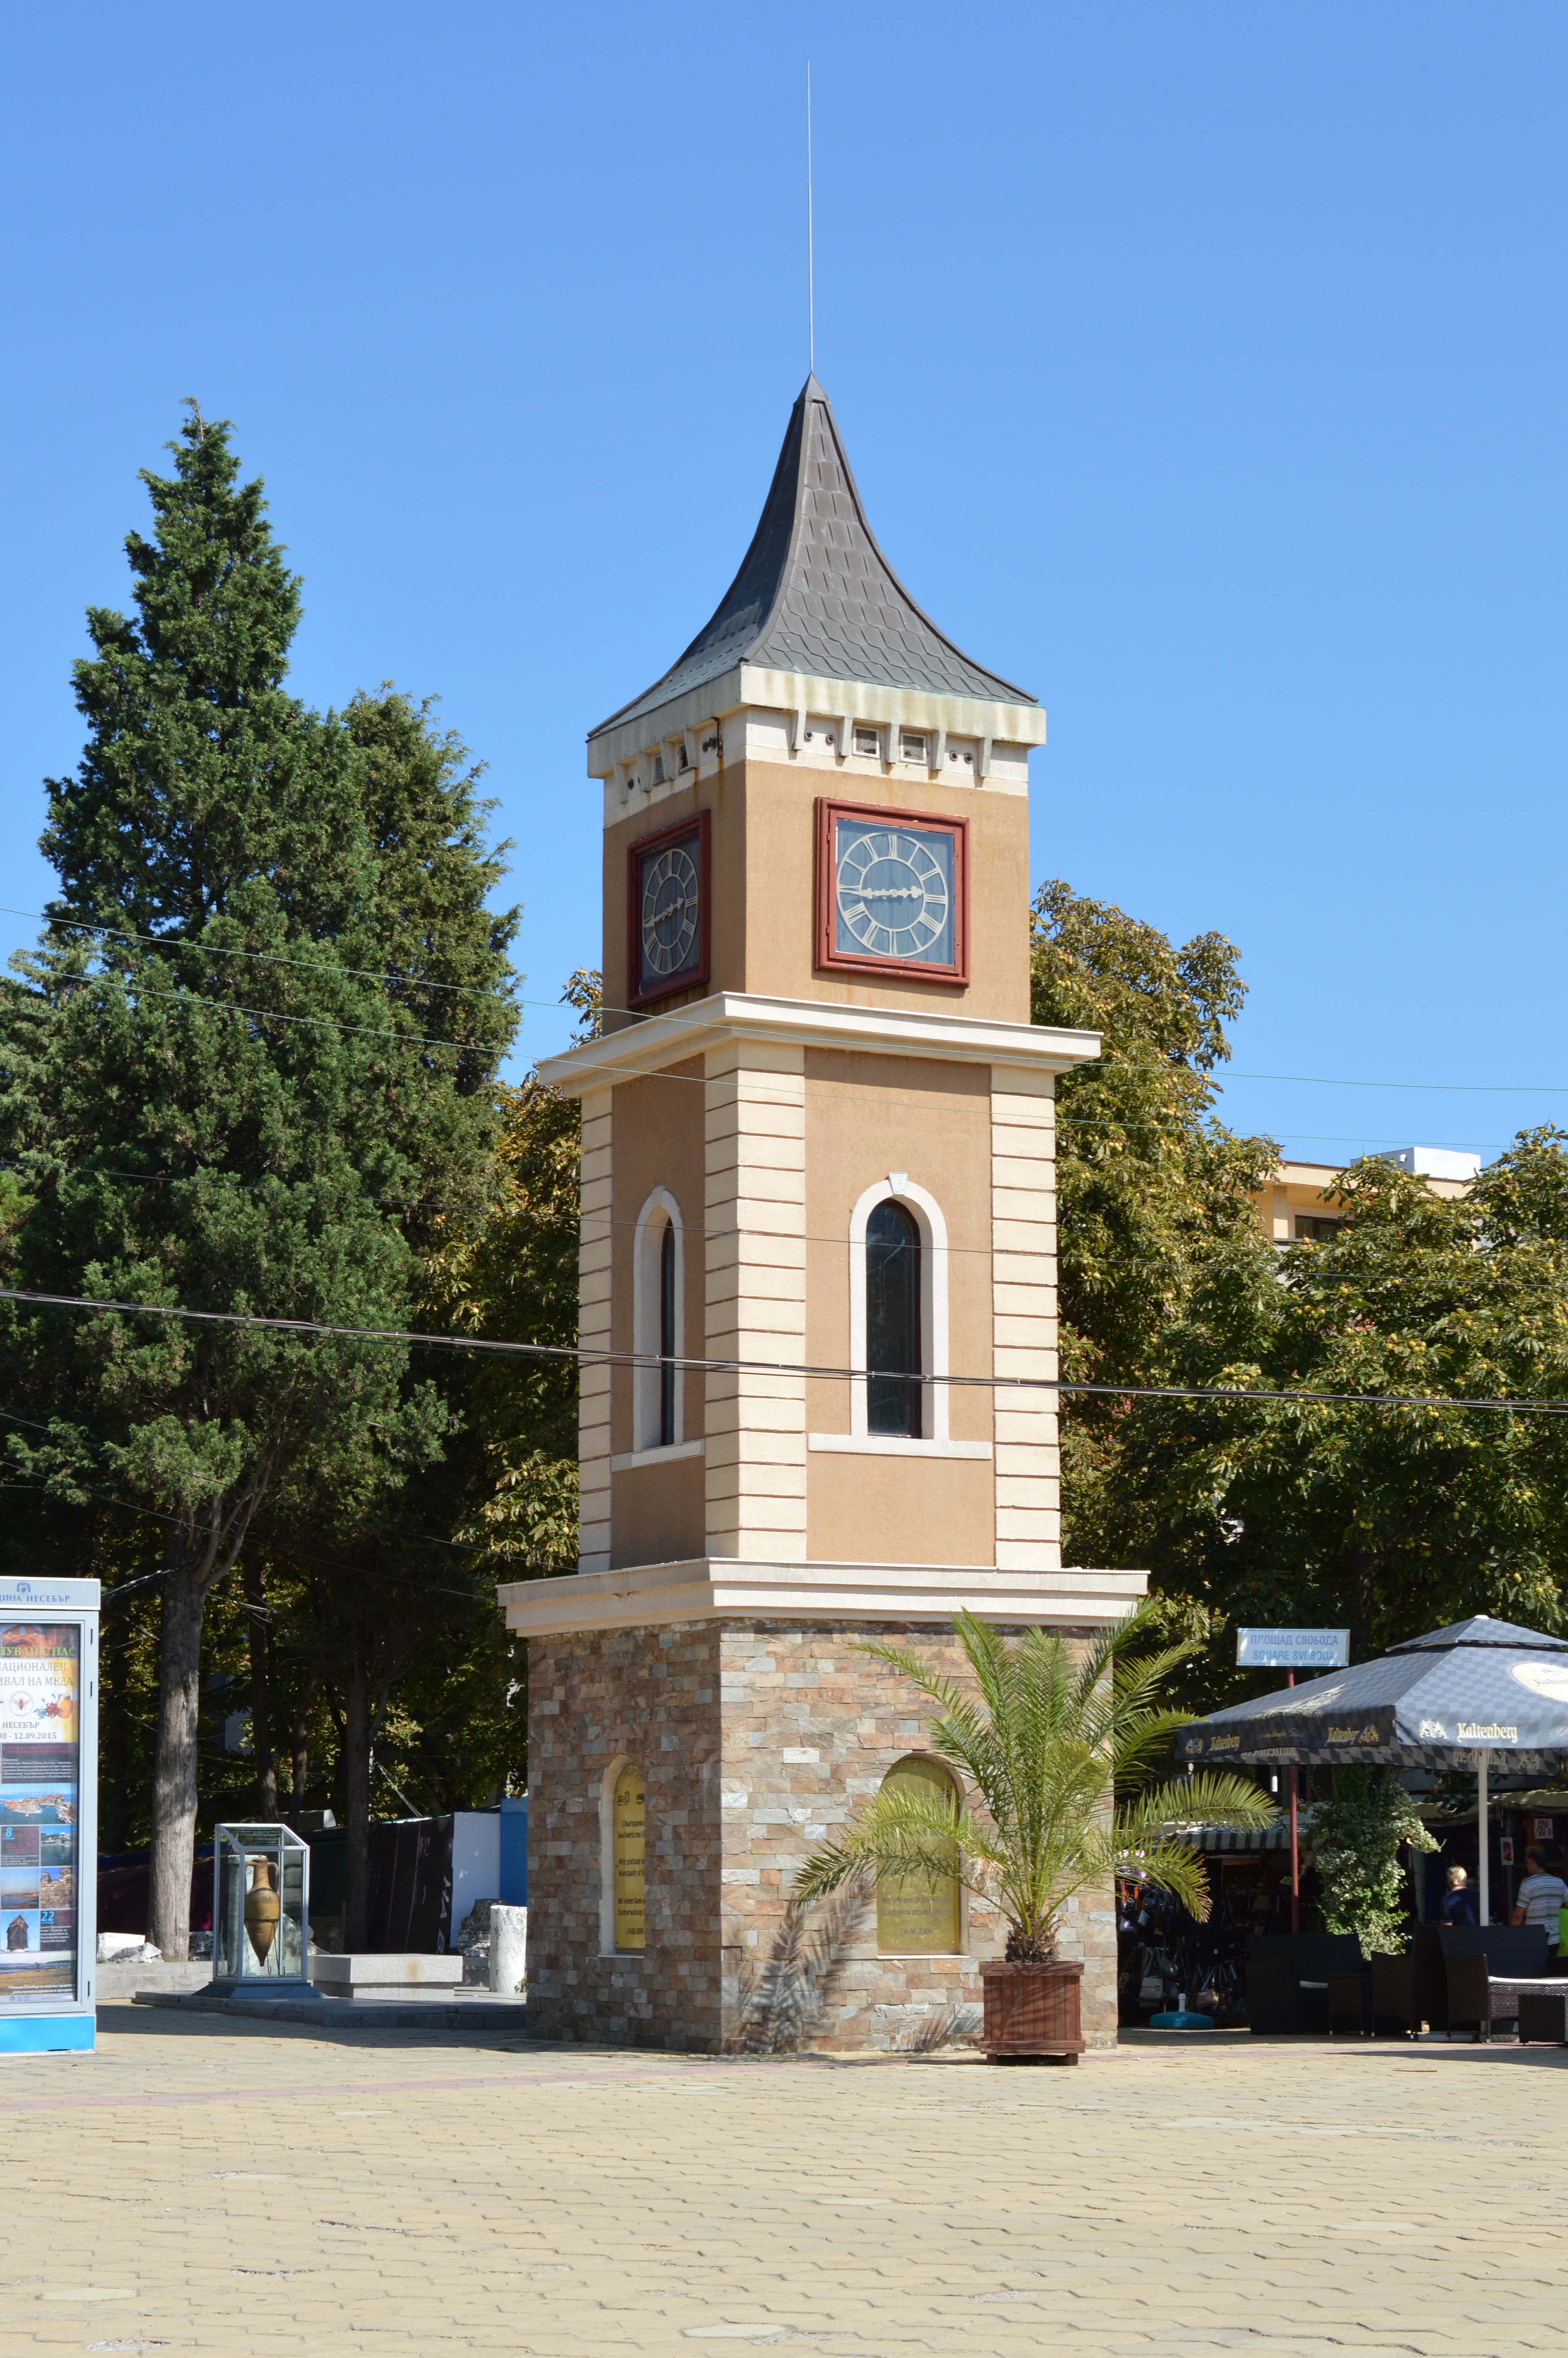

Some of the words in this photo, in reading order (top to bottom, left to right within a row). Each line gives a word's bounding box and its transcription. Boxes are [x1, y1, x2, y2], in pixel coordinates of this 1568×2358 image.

[1250, 1635, 1293, 1646] ПЛОЩАД
[1296, 1635, 1338, 1646] СВОБОДА
[42, 1647, 50, 1656] С
[52, 1647, 76, 1656] НАС
[1253, 1650, 1290, 1660] SQUARE
[1293, 1650, 1335, 1660] SVOBODA
[0, 1662, 66, 1673] АЦИОНАЛЕН
[28, 1677, 42, 1685] НА
[45, 1677, 73, 1686] МЕДА
[1456, 1722, 1518, 1744] Kaltenberg
[5, 1827, 13, 1837] 8
[41, 1911, 54, 1921] 22
